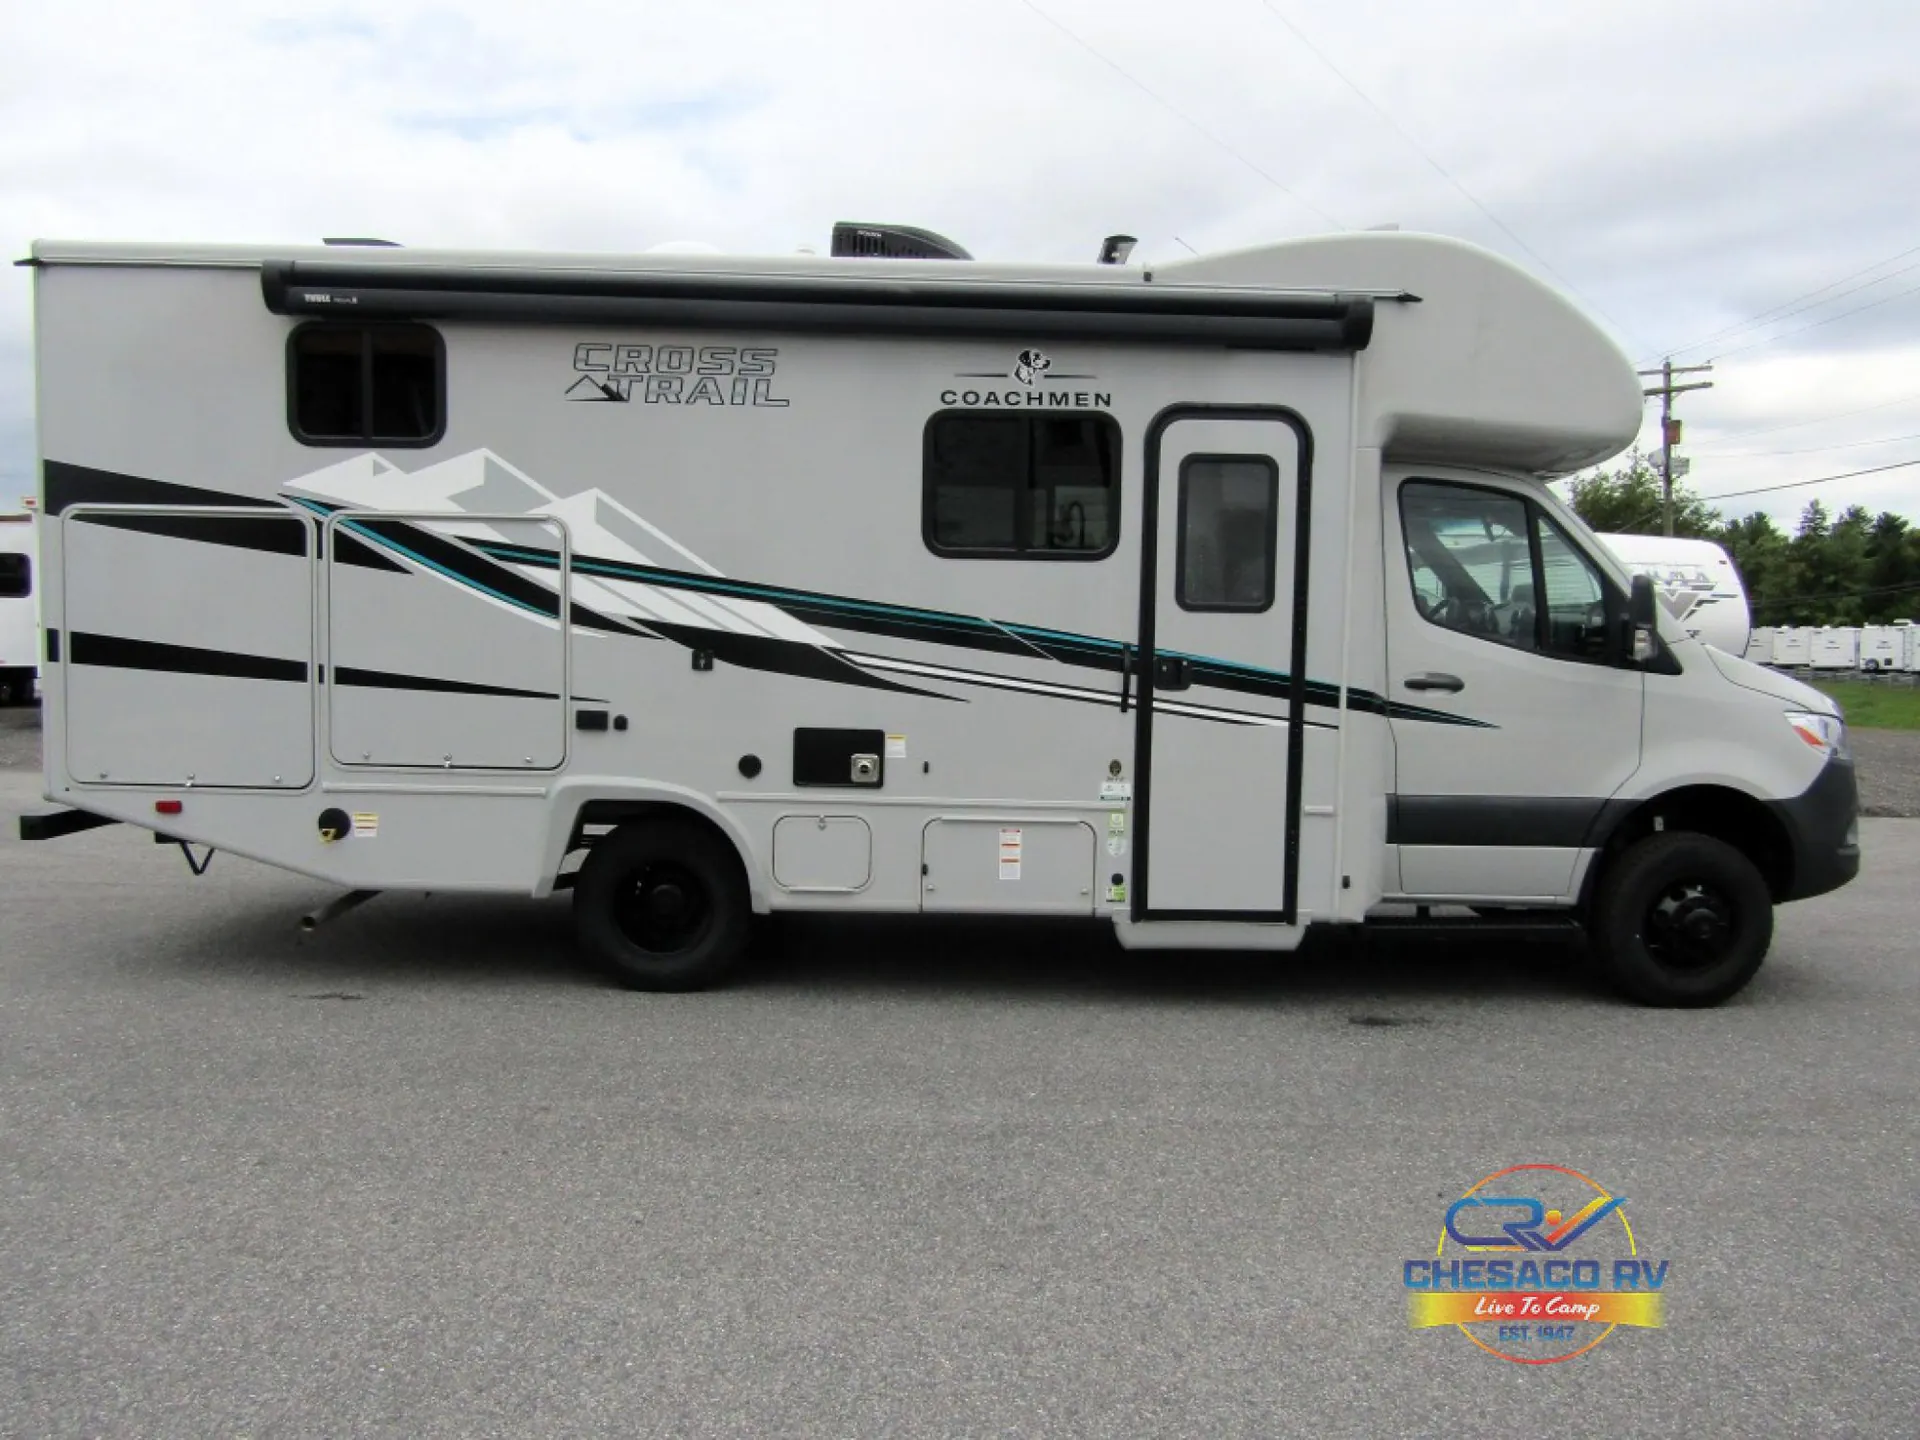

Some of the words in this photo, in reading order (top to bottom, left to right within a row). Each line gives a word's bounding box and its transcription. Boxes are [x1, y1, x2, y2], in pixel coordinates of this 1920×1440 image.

[573, 343, 778, 376] CROSS
[607, 374, 790, 407] TRAIL
[940, 389, 1112, 408] COACHMEN
